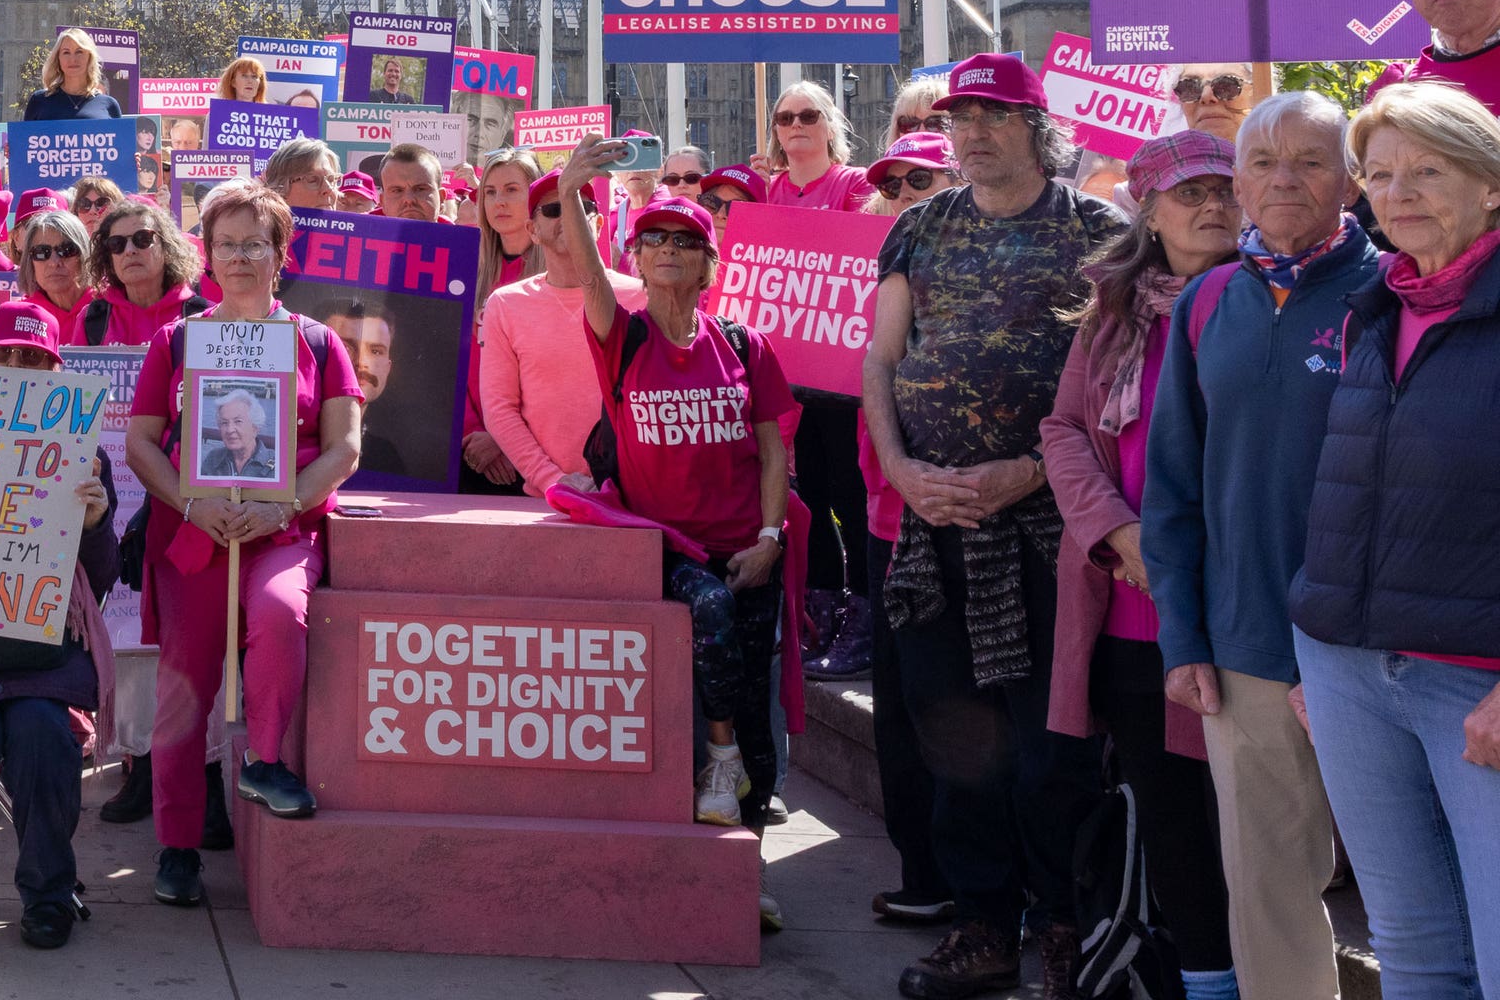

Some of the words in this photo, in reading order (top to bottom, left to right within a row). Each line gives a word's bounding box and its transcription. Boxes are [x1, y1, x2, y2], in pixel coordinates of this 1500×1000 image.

[354, 16, 423, 32] CAMPAIGN
[426, 20, 452, 32] FOR
[618, 18, 711, 30] LEGALISE
[720, 16, 816, 30] ASSISTED
[826, 17, 887, 30] DYING
[386, 34, 418, 46] ROB
[1106, 31, 1168, 42] DIGNITY
[242, 41, 308, 55] CAMPAIGN
[312, 44, 338, 56] FOR
[1106, 42, 1120, 52] IN
[1122, 40, 1174, 51] DYING.
[276, 58, 302, 70] IAN
[162, 96, 206, 106] DAVID
[230, 112, 249, 124] SO
[253, 114, 289, 128] THAT
[293, 118, 298, 128] I
[520, 114, 578, 128] CAMPAIGN
[582, 112, 604, 123] FOR
[1075, 90, 1168, 136] JOHN
[28, 135, 50, 148] SO
[55, 134, 78, 148] I'M
[83, 133, 116, 146] NOT
[416, 132, 440, 141] Death
[27, 150, 92, 164] FORCED
[96, 148, 119, 162] TO
[176, 154, 227, 162] CAMPAIGN
[230, 154, 250, 162] FOR
[38, 162, 108, 178] SUFFER.
[188, 166, 238, 176] JAMES
[731, 243, 834, 273] CAMPAIGN
[839, 256, 878, 278] FOR
[722, 263, 878, 313] DIGNITY
[220, 323, 264, 342] MUM
[716, 298, 752, 327] IN
[757, 303, 874, 351] DYING.
[206, 344, 264, 356] DESERVED
[65, 358, 128, 370] CAMPAIGN
[216, 358, 262, 370] BETTER
[629, 388, 712, 404] CAMPAIGN
[717, 386, 744, 399] FOR
[631, 399, 744, 424] DIGNITY
[637, 422, 660, 446] IN
[665, 420, 748, 446] DYING.
[14, 438, 60, 478] TO
[364, 622, 648, 672] TOGETHER
[368, 669, 452, 705] FOR
[467, 672, 646, 712] DIGNITY
[364, 708, 408, 754] &
[424, 709, 646, 763] CHOICE
